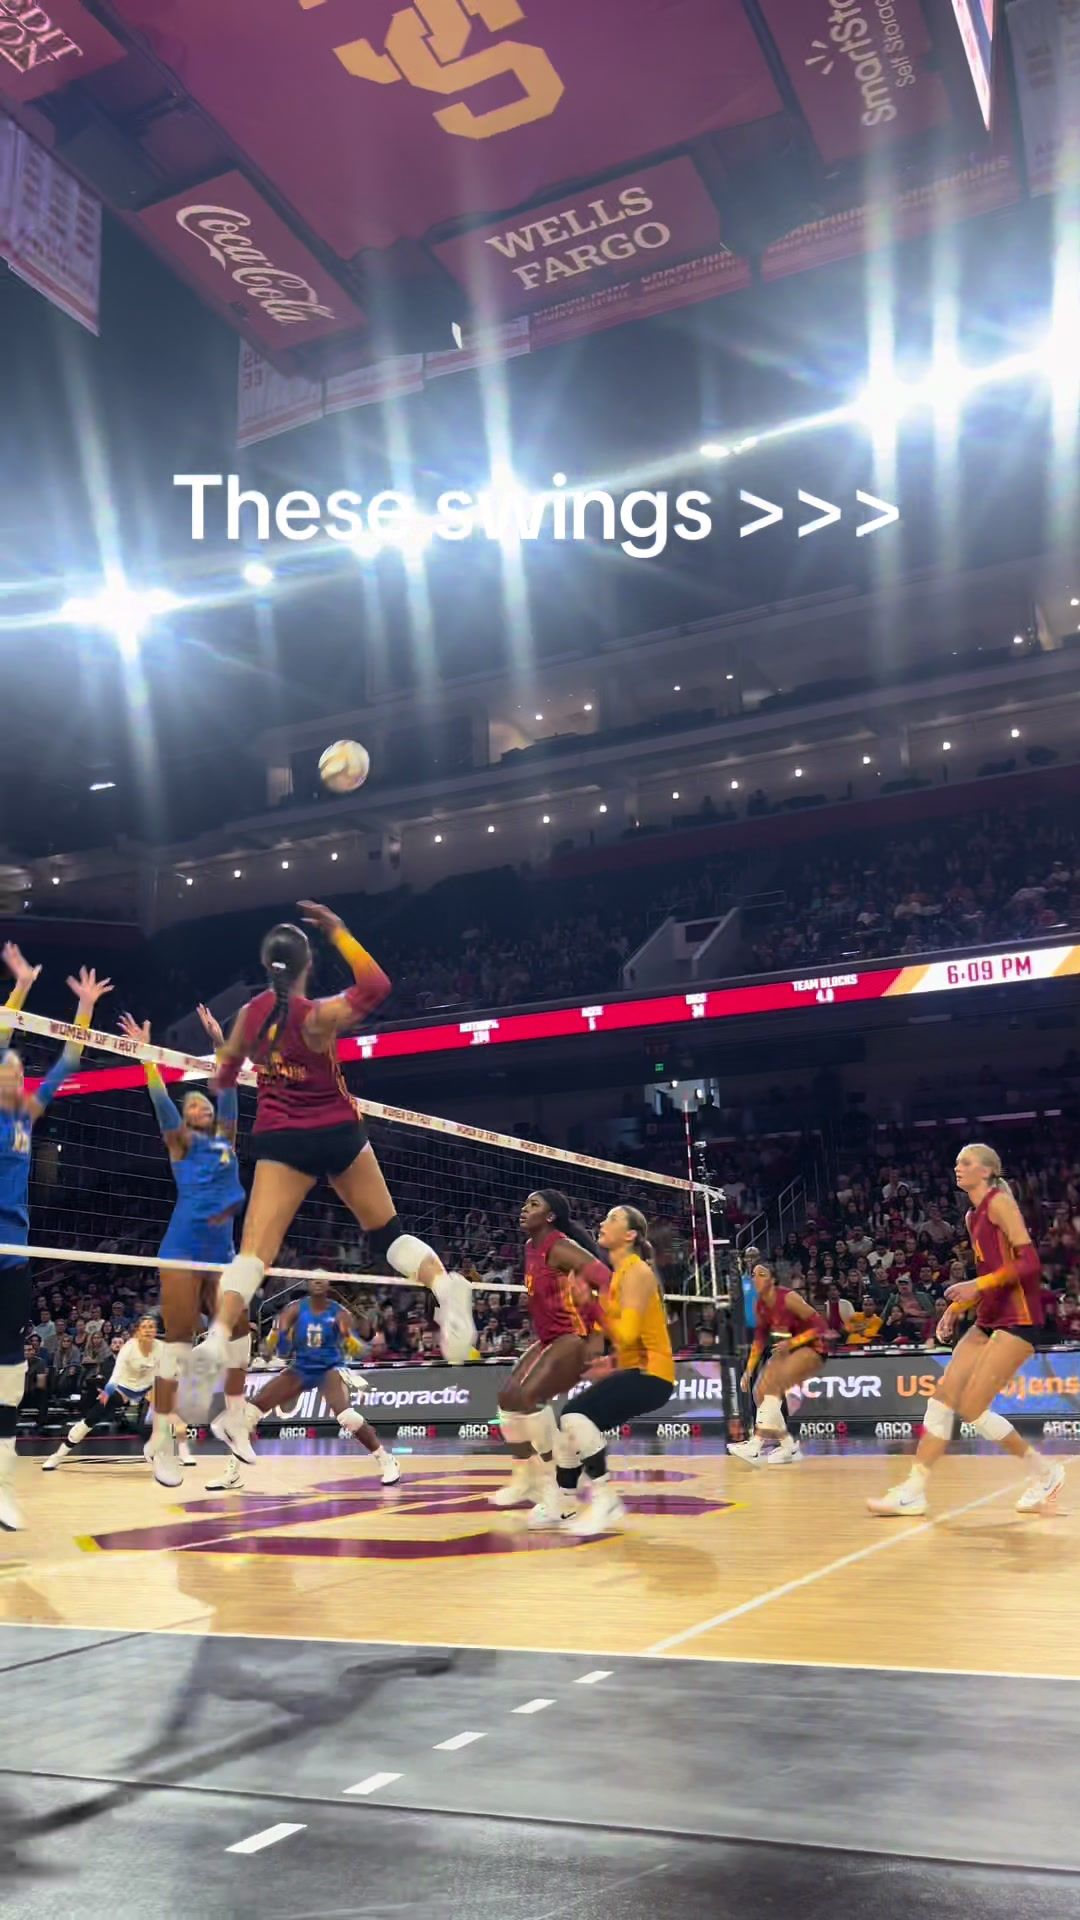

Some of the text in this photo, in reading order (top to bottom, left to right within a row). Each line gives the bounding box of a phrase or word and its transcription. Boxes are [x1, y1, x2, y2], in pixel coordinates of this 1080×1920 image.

[889, 55, 916, 87] Self
[484, 187, 653, 260] WELLS
[176, 205, 335, 325] Coca-Cola
[512, 222, 671, 291] FARGO
[1001, 956, 1032, 979] PM
[792, 974, 859, 992] TEAM BLOCKS
[50, 1022, 139, 1053] WOMEN OF TROY
[669, 1379, 722, 1400] HIR
[897, 1375, 945, 1397] US
[279, 1427, 306, 1440] ARCO
[397, 1424, 426, 1438] ARCO
[458, 1424, 489, 1438] ARCO
[656, 1423, 690, 1437] ARCO
[800, 1422, 834, 1436] ARCO
[875, 1422, 912, 1437] ARCO
